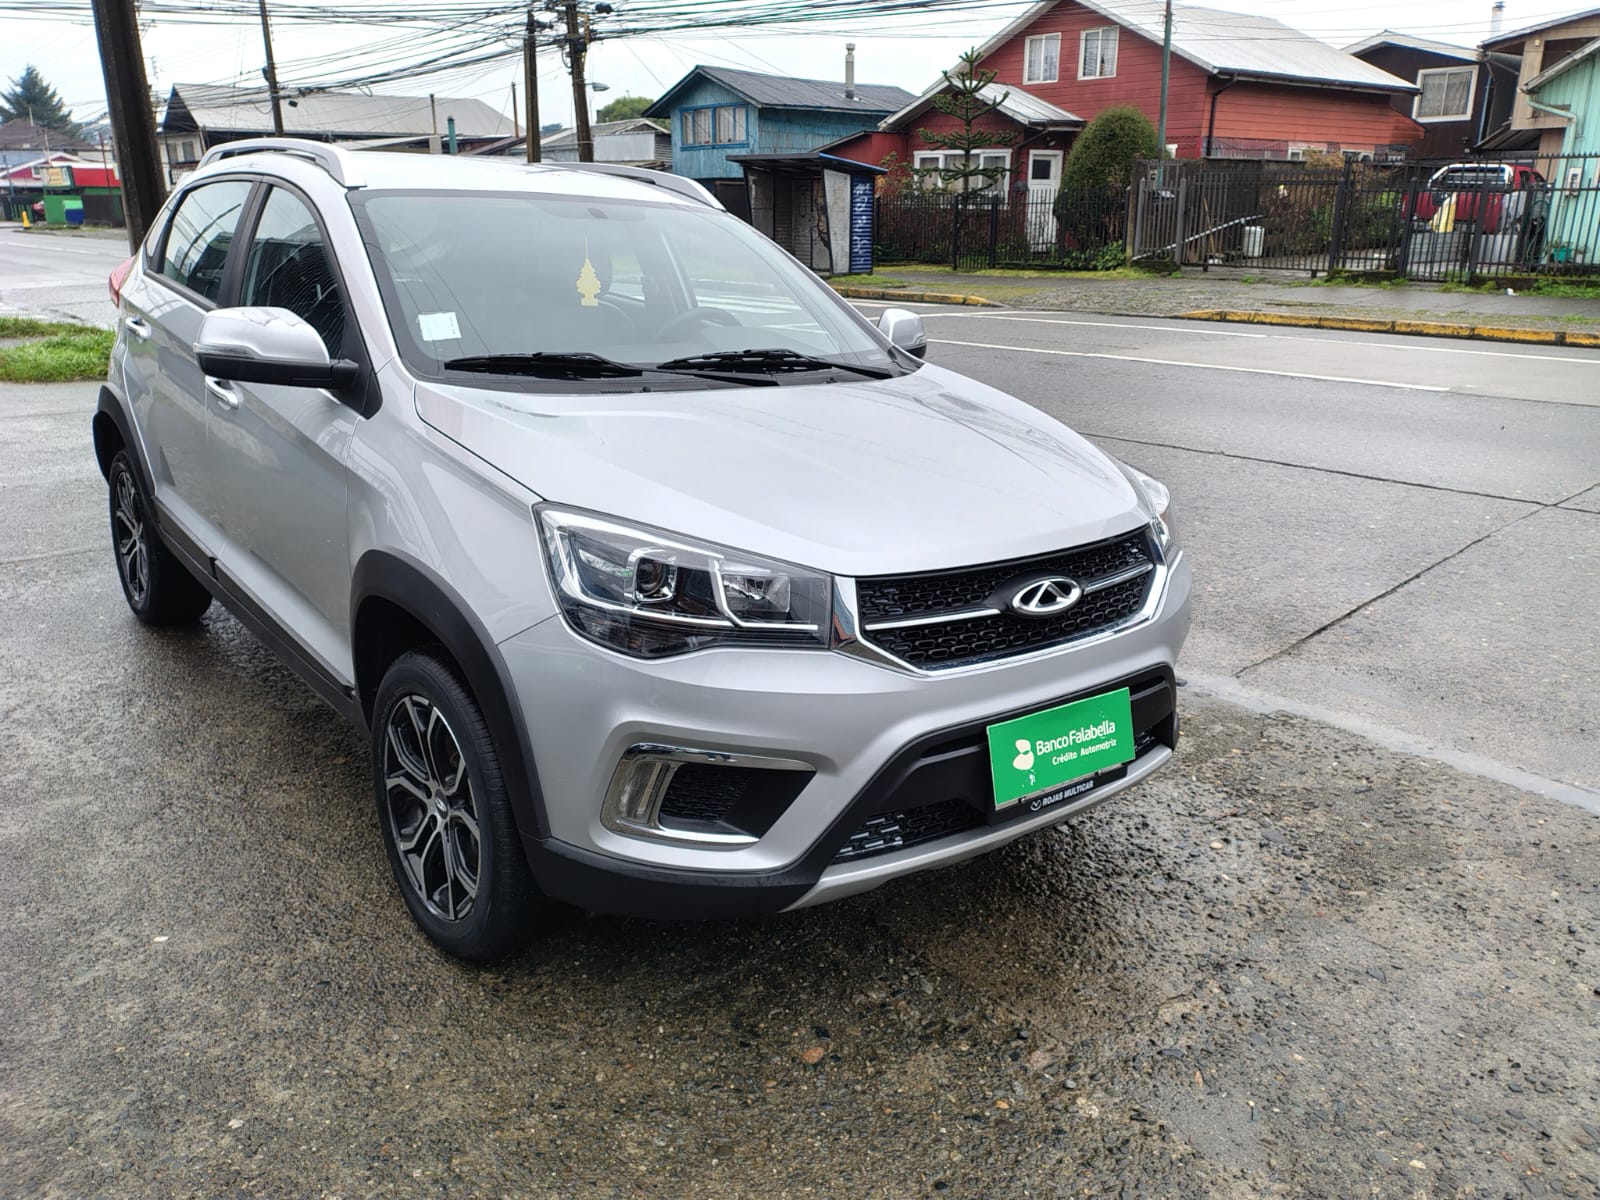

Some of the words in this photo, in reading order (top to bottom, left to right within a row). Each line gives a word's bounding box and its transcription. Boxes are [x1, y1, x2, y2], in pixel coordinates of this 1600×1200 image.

[1052, 751, 1077, 765] Crédito
[1080, 738, 1117, 756] Automotriz
[1042, 791, 1063, 806] ROJAS
[1063, 780, 1094, 798] MULTICAR
